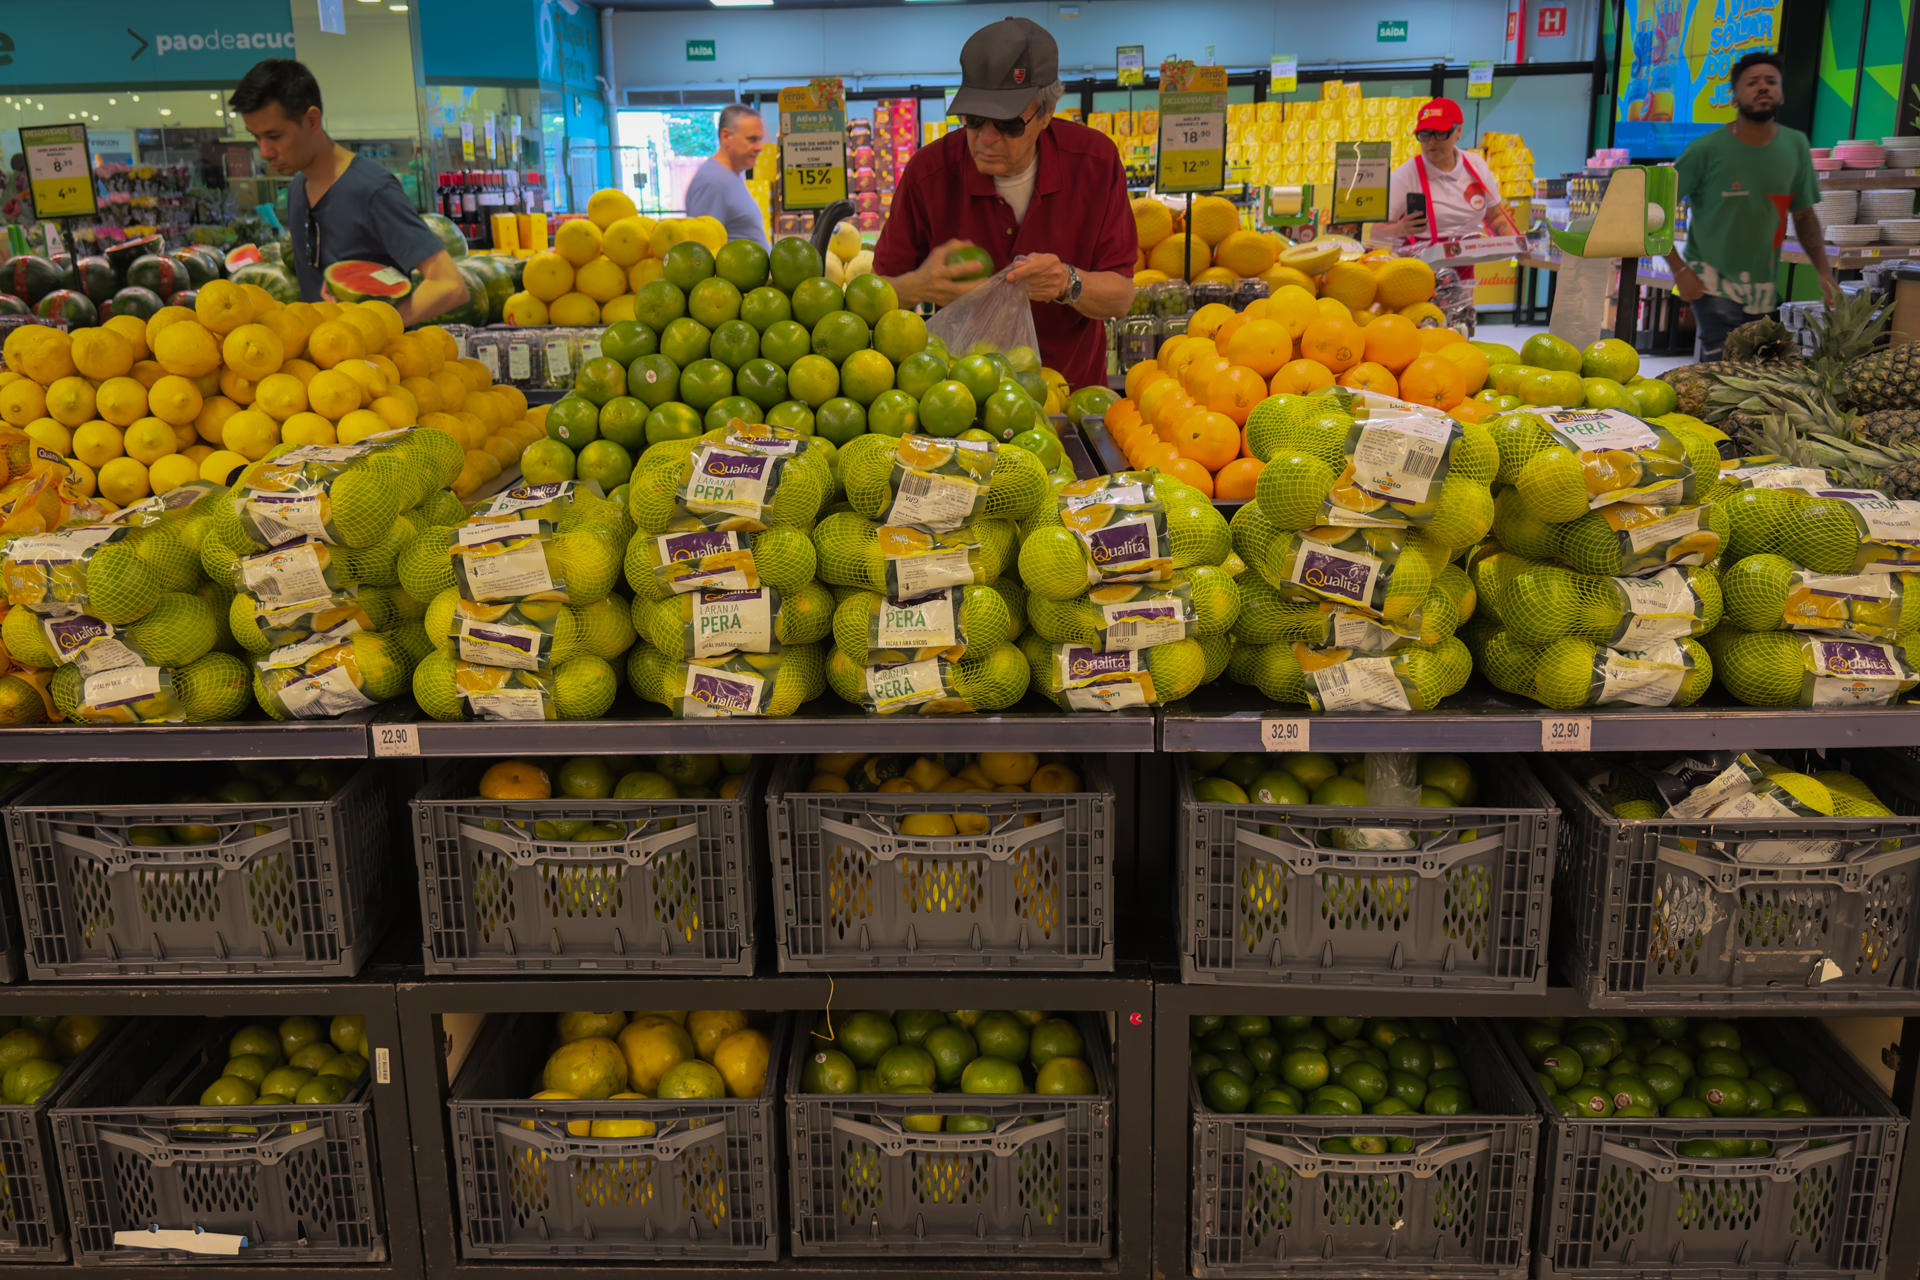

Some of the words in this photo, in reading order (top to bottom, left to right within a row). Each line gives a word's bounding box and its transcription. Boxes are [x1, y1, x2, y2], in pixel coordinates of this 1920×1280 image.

[1545, 11, 1560, 30] H
[1380, 27, 1406, 37] SAÍDA
[1710, 14, 1774, 49] SOLAR
[688, 45, 713, 56] SAÍDA
[797, 169, 832, 185] 15%
[1564, 421, 1612, 437] PERA
[708, 461, 761, 476] Qualitá
[697, 477, 737, 489] LARANJA
[1372, 476, 1402, 489] Lucato
[693, 484, 735, 501] PERA
[1094, 538, 1146, 563] Qualitá
[1306, 567, 1362, 594] Qualitá
[699, 604, 739, 615] LARANJA
[701, 613, 742, 635] PERA
[886, 610, 927, 628] PERA
[1073, 654, 1127, 676] Qualitá
[874, 677, 916, 698] PERA
[381, 729, 408, 744] 22,90
[1271, 723, 1299, 741] 32,90
[1552, 722, 1580, 740] 32,90
